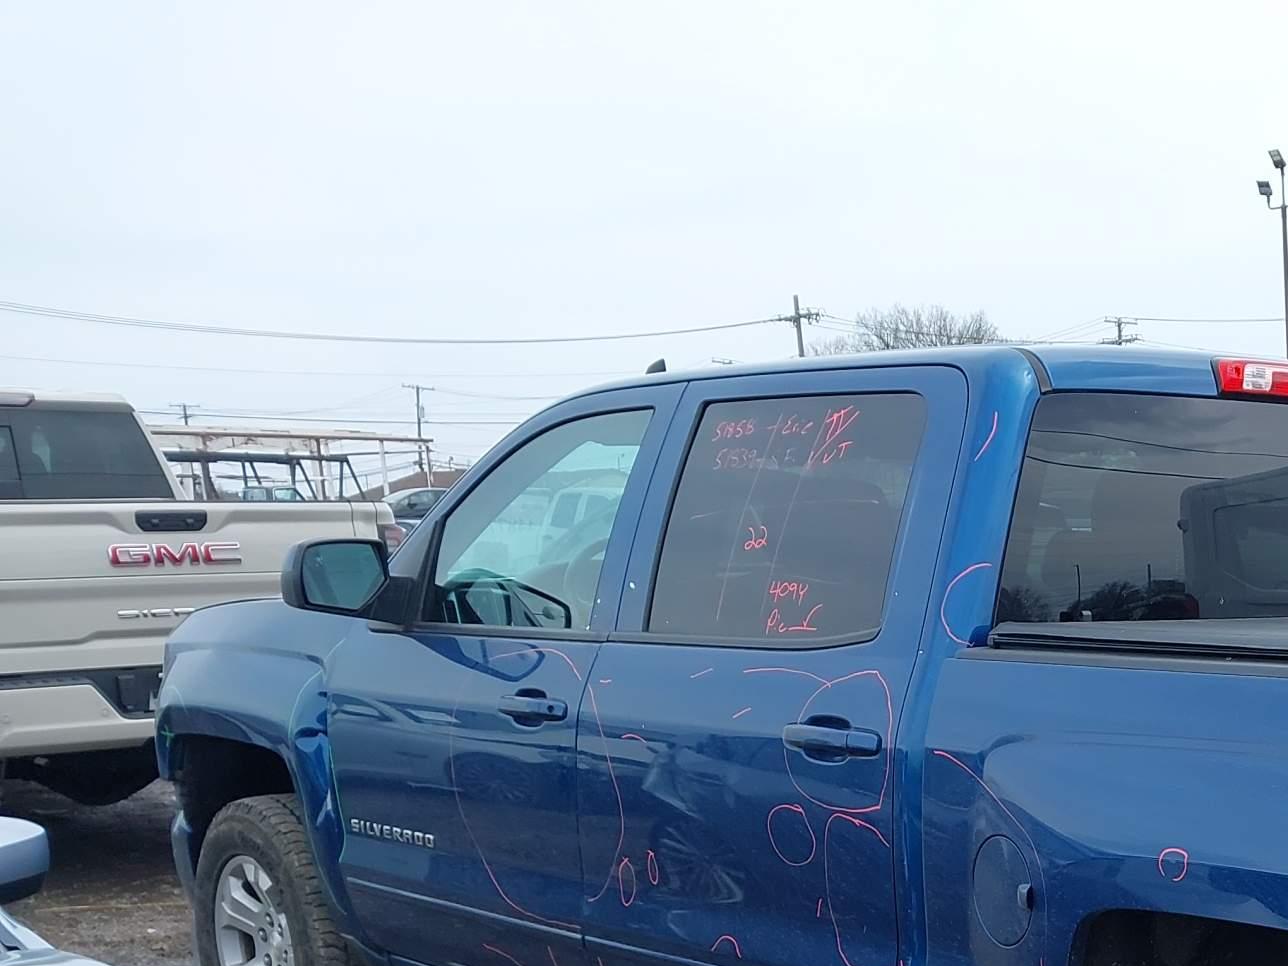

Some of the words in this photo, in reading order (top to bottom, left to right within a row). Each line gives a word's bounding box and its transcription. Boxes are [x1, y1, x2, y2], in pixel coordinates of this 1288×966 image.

[744, 525, 768, 551] 22
[107, 541, 243, 567] GMC
[350, 818, 435, 849] SILVERADO
